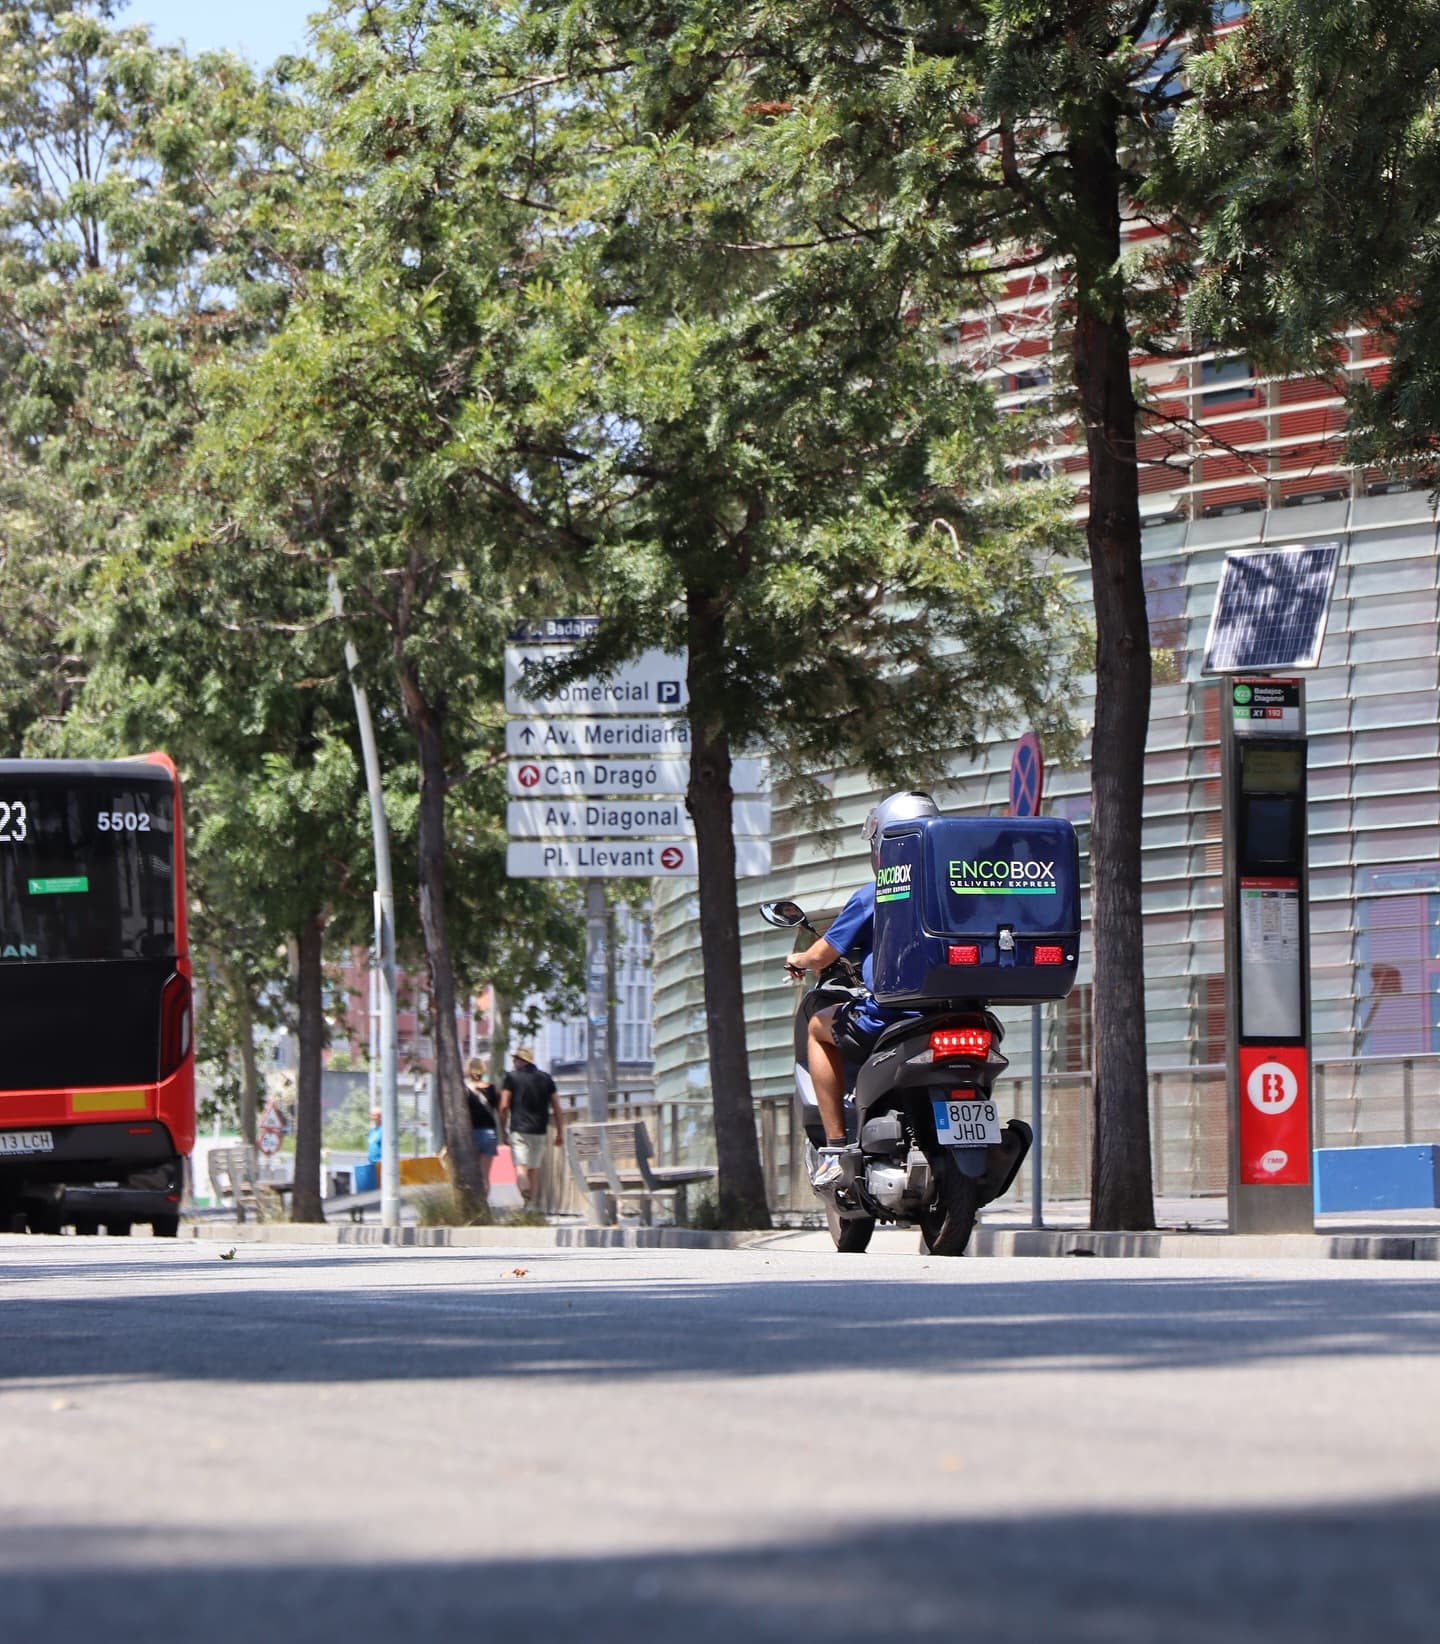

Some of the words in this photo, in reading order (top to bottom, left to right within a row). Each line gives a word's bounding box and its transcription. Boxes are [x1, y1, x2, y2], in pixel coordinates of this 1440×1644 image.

[544, 726, 576, 744] Av.
[585, 725, 688, 744] Meridiana
[545, 766, 585, 785] Can
[594, 765, 657, 789] Dragó
[97, 812, 150, 831] 5502
[545, 808, 576, 826] Av.
[586, 807, 678, 830] Diagonal
[544, 848, 568, 866] Pl.
[578, 848, 654, 866] Llevant
[877, 864, 912, 887] ENCOBOX
[949, 860, 1055, 879] ENCOBOX
[950, 1104, 995, 1121] 8078
[953, 1123, 986, 1140] JHD
[22, 1134, 49, 1149] LCH
